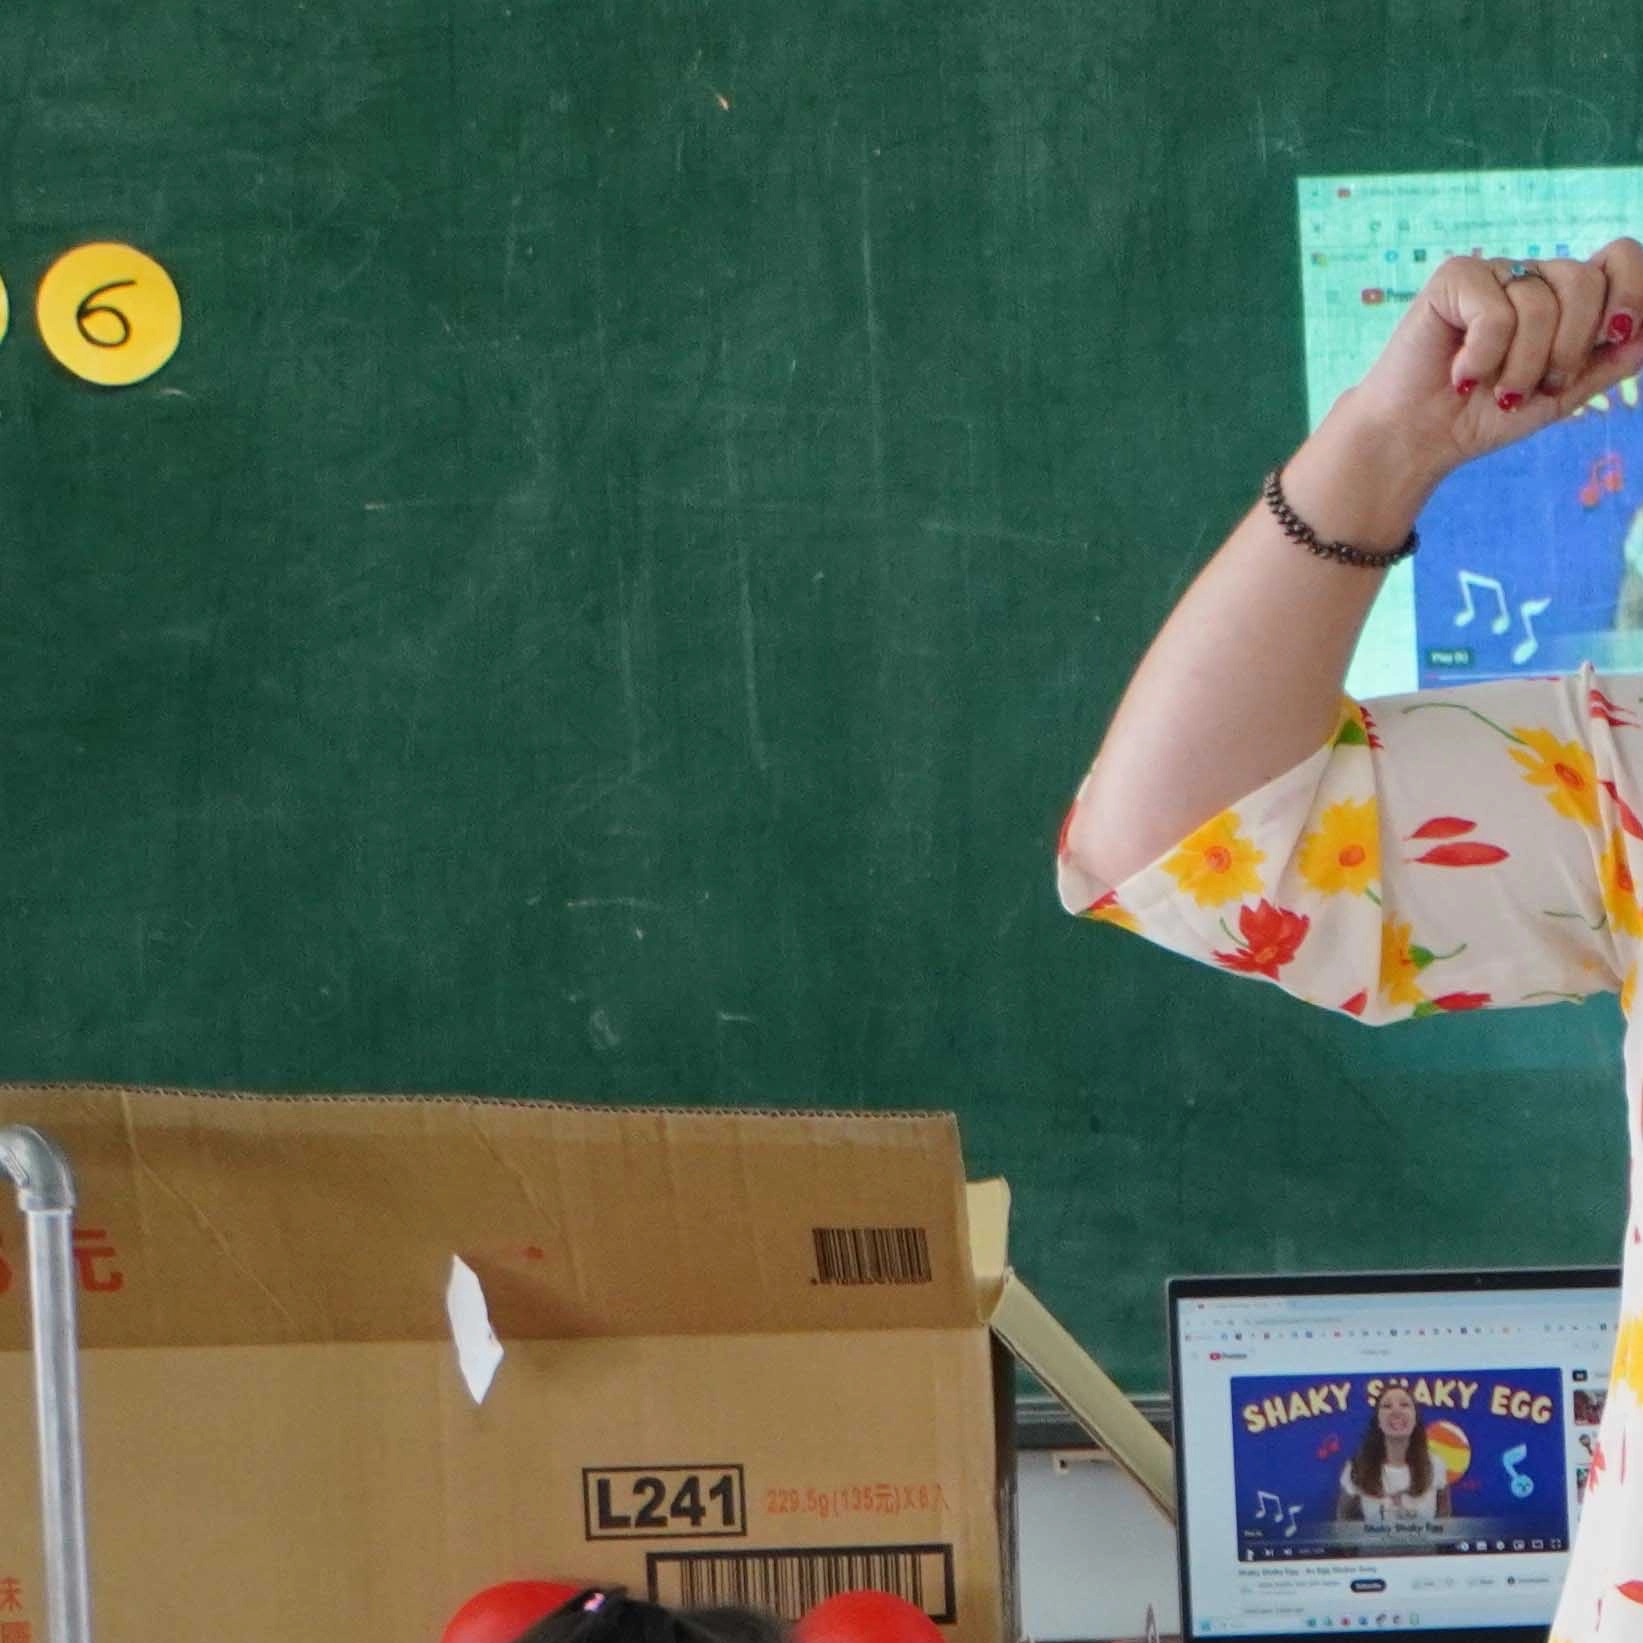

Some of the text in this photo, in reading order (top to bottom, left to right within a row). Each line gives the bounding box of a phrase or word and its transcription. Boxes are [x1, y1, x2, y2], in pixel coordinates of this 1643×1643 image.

[76, 278, 136, 348] 6
[1242, 1377, 1553, 1434] SHAKY SAKY EGG
[596, 1474, 736, 1530] L241
